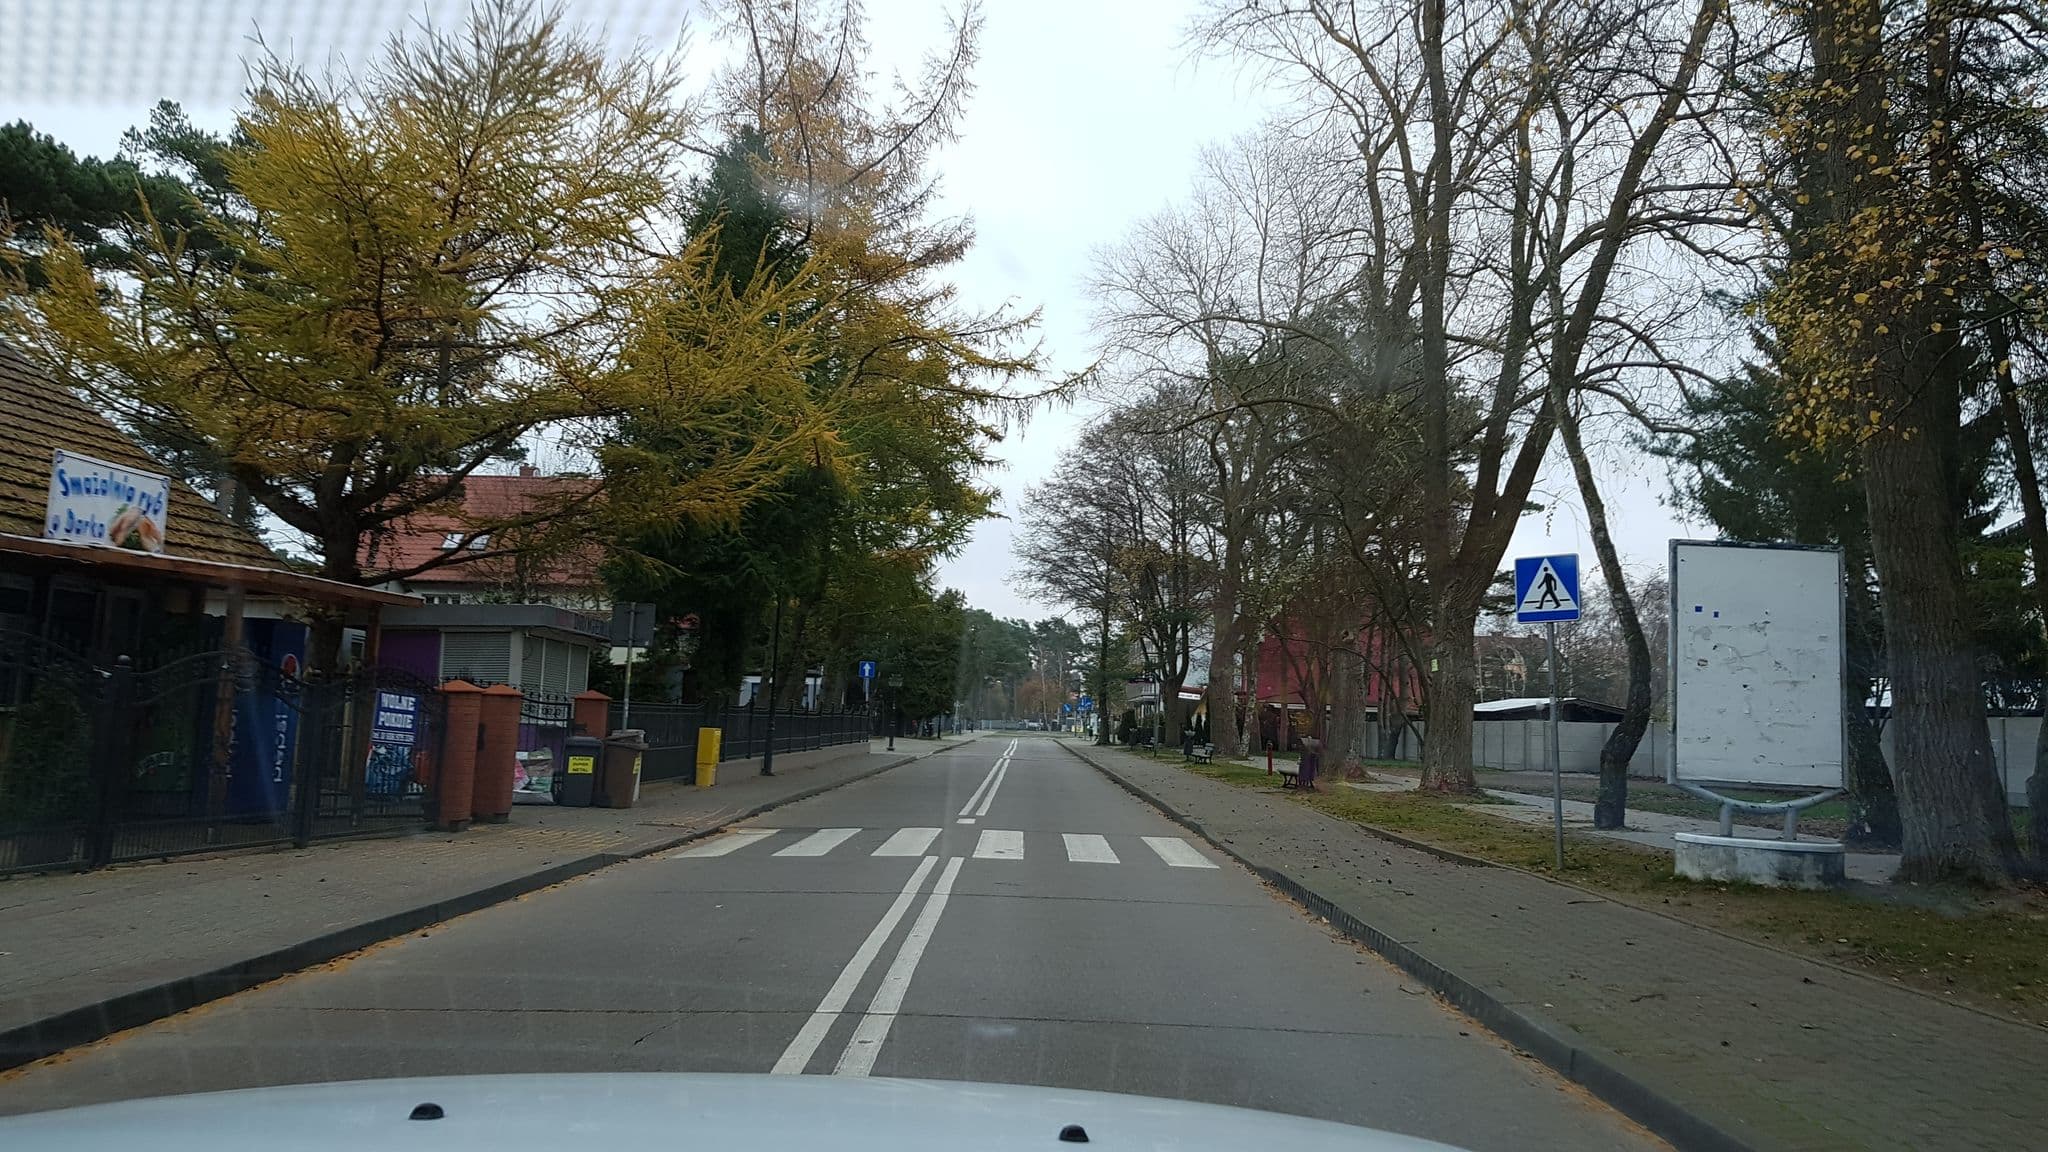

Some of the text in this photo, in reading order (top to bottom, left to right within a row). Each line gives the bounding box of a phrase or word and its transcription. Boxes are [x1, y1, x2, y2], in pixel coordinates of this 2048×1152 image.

[139, 490, 163, 516] ryb
[381, 692, 416, 711] WOLNE
[378, 711, 414, 729] POKOJE
